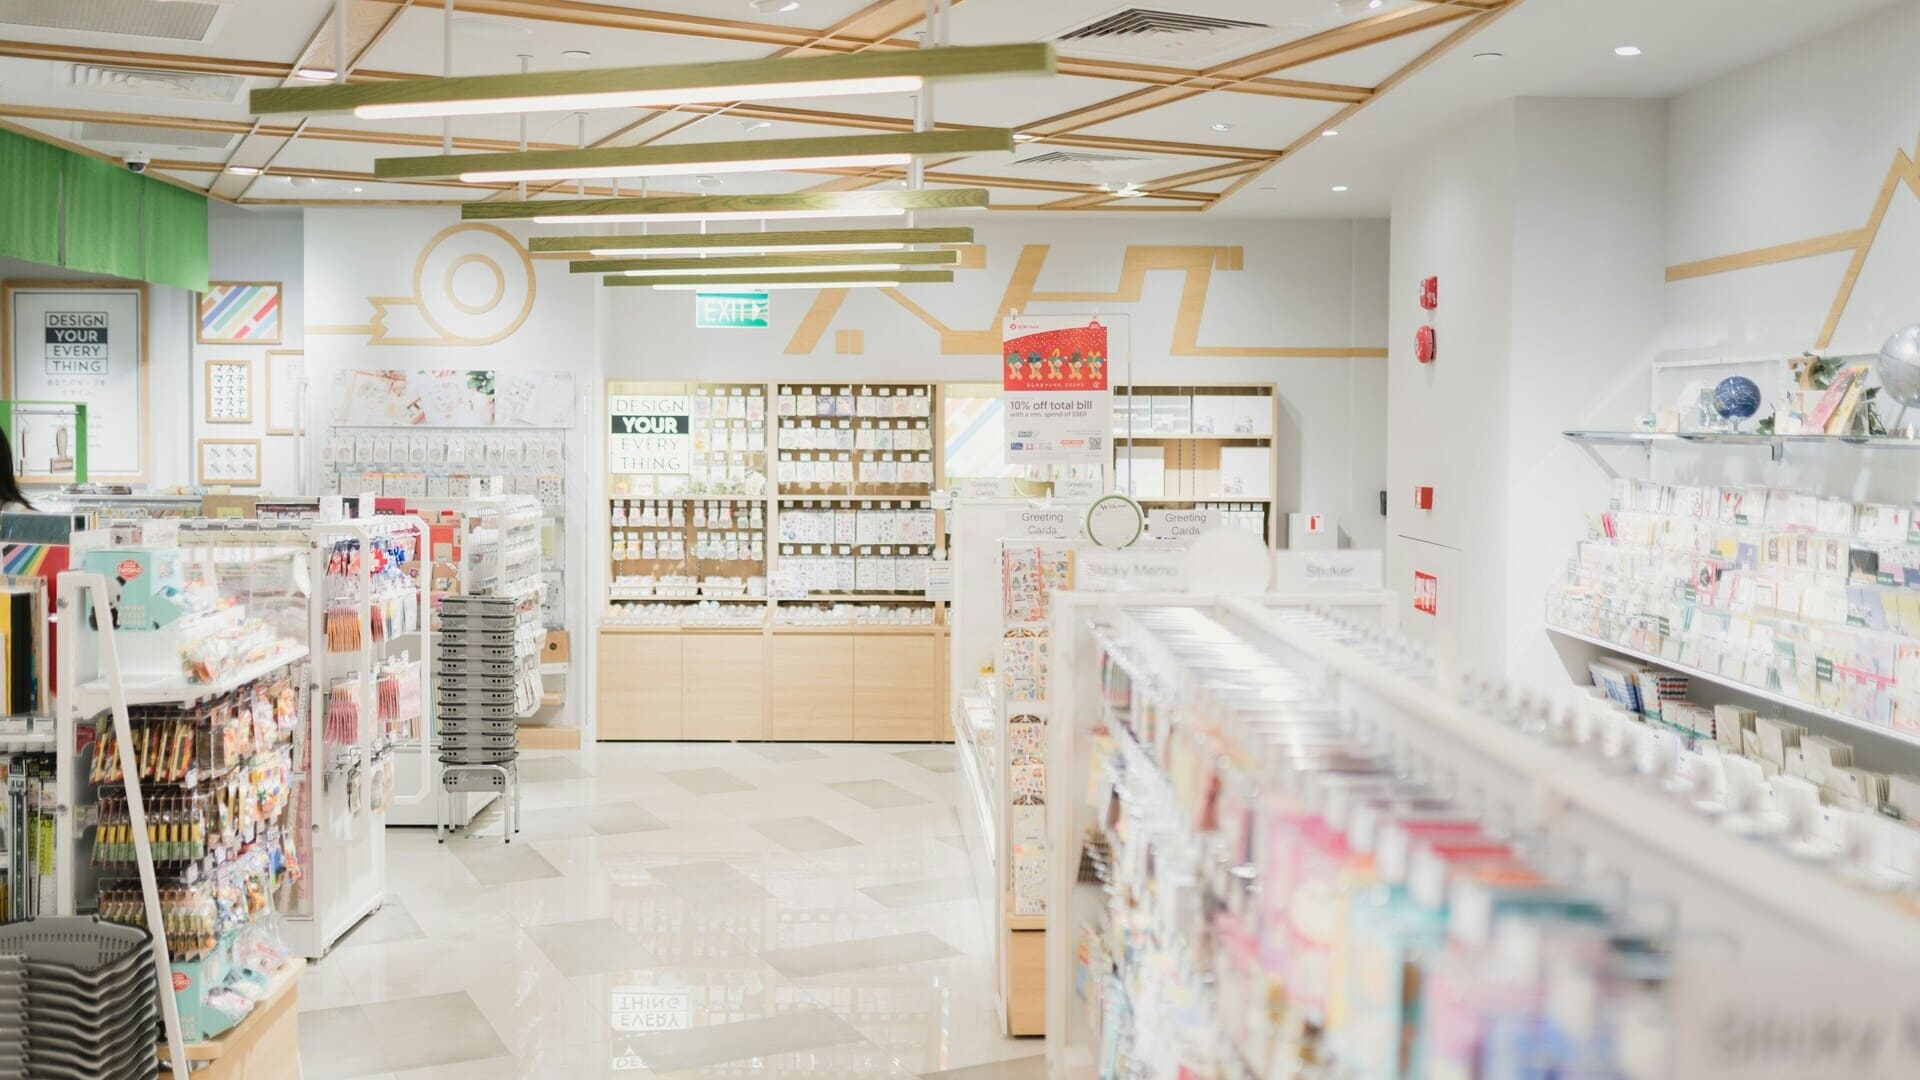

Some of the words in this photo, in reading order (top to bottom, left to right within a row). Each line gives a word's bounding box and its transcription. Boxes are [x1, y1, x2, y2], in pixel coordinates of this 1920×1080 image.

[704, 301, 747, 322] EXIT
[49, 314, 104, 326] DESIGN
[54, 329, 98, 342] YOUR
[53, 345, 100, 356] EVERY
[52, 360, 101, 372] THING
[616, 399, 684, 412] DESIGN
[1010, 400, 1030, 410] 10%
[1033, 400, 1047, 410] off
[1050, 400, 1074, 410] total
[1077, 400, 1092, 410] bill
[622, 416, 678, 433] YOUR
[621, 437, 679, 450] EVERY
[620, 456, 680, 470] THING
[971, 481, 999, 490] Greeting
[1065, 481, 1093, 489] Greeting
[1021, 512, 1064, 523] Greeting
[1165, 512, 1207, 523] Greeting
[1028, 525, 1057, 535] Cards
[1171, 526, 1200, 535] Cards
[1088, 562, 1128, 577] Sticky
[1134, 563, 1178, 576] Memo
[1306, 564, 1353, 577] Sticker
